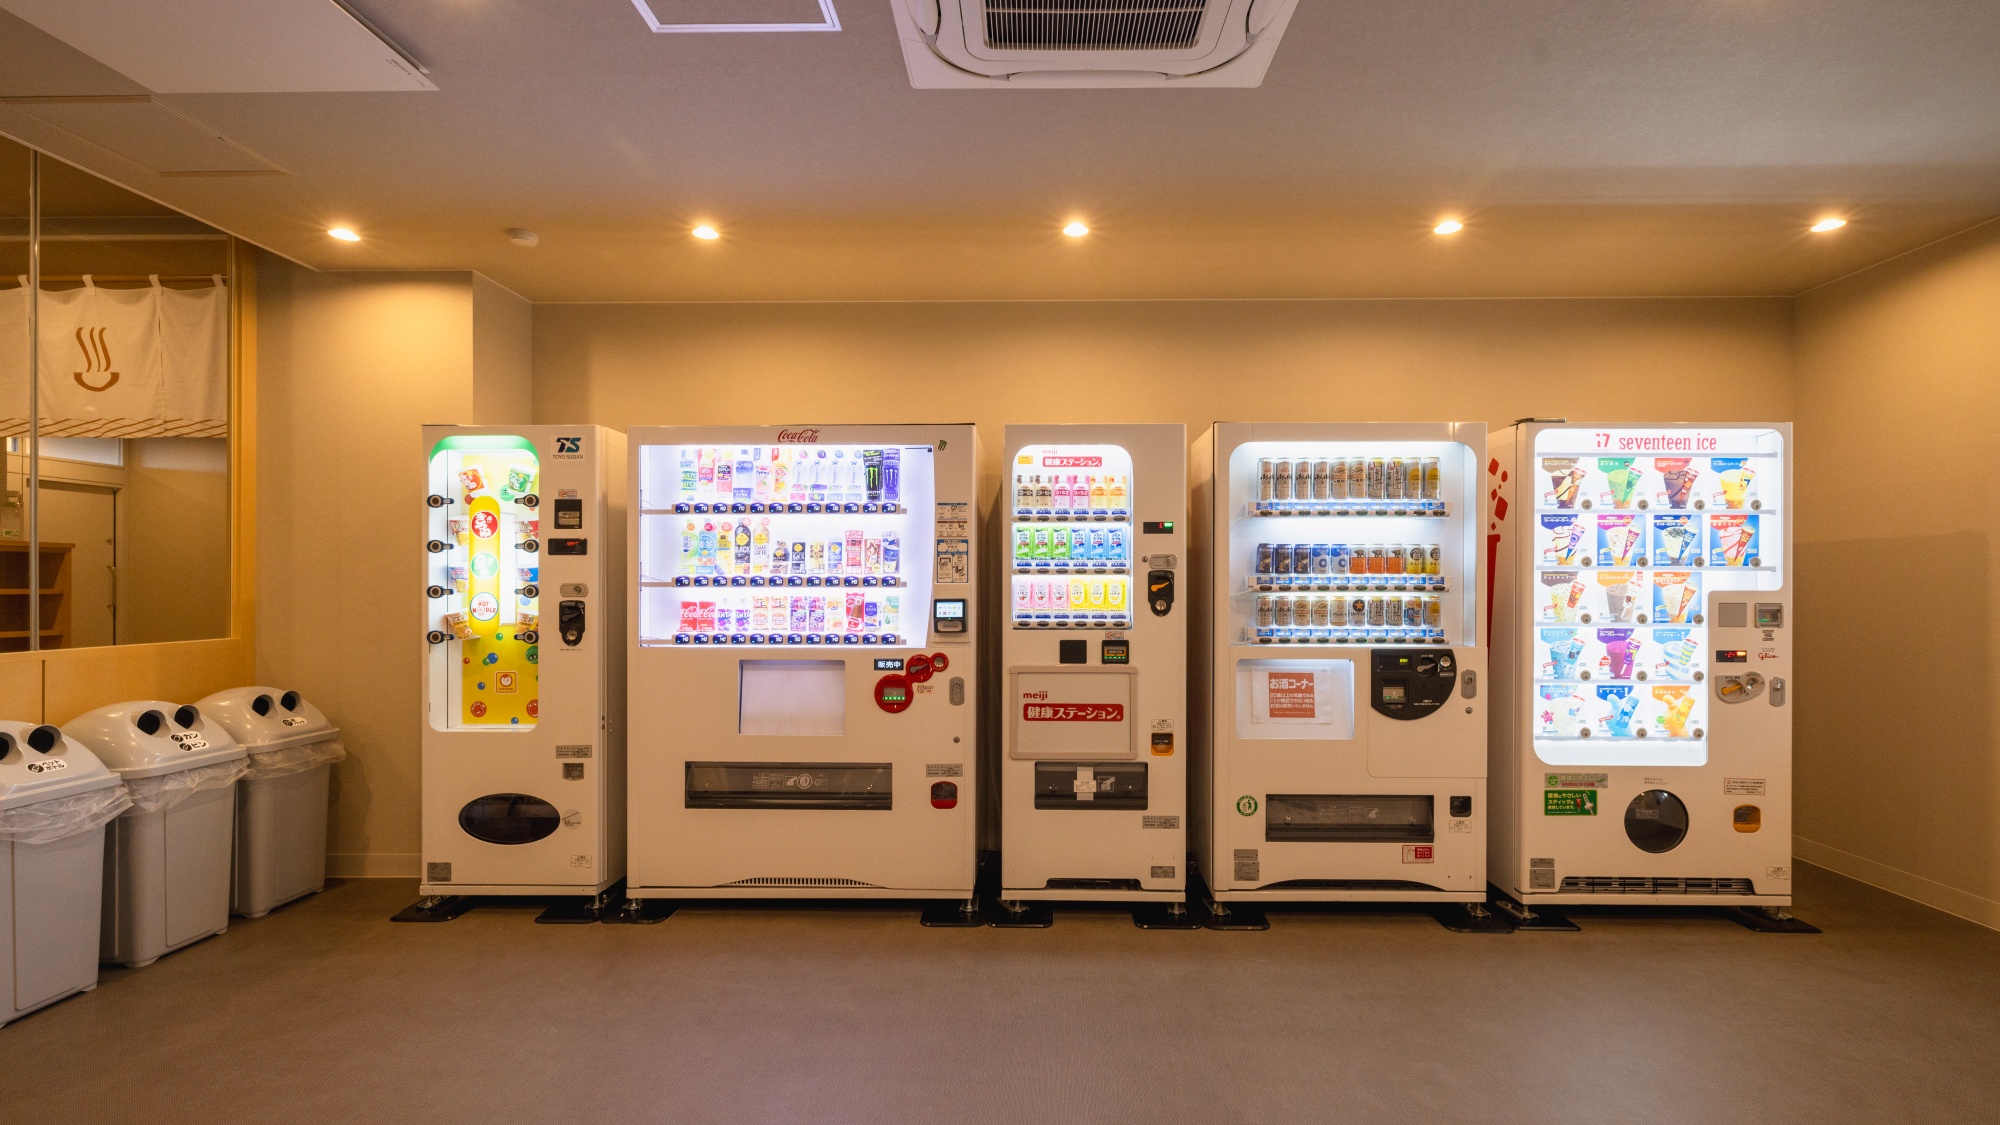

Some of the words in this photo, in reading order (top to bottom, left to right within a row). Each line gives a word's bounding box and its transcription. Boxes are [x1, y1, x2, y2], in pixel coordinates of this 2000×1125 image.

[556, 437, 582, 453] TS
[1619, 434, 1692, 451] seventeen
[1696, 432, 1717, 451] ice
[1044, 458, 1100, 467] 健康ステーション
[877, 660, 901, 668] 販売中
[1269, 678, 1314, 690] お酒コーナー
[1023, 691, 1048, 701] meiji
[1027, 706, 1118, 719] 健康ステーション
[183, 732, 198, 740] カン
[191, 741, 206, 749] ビン
